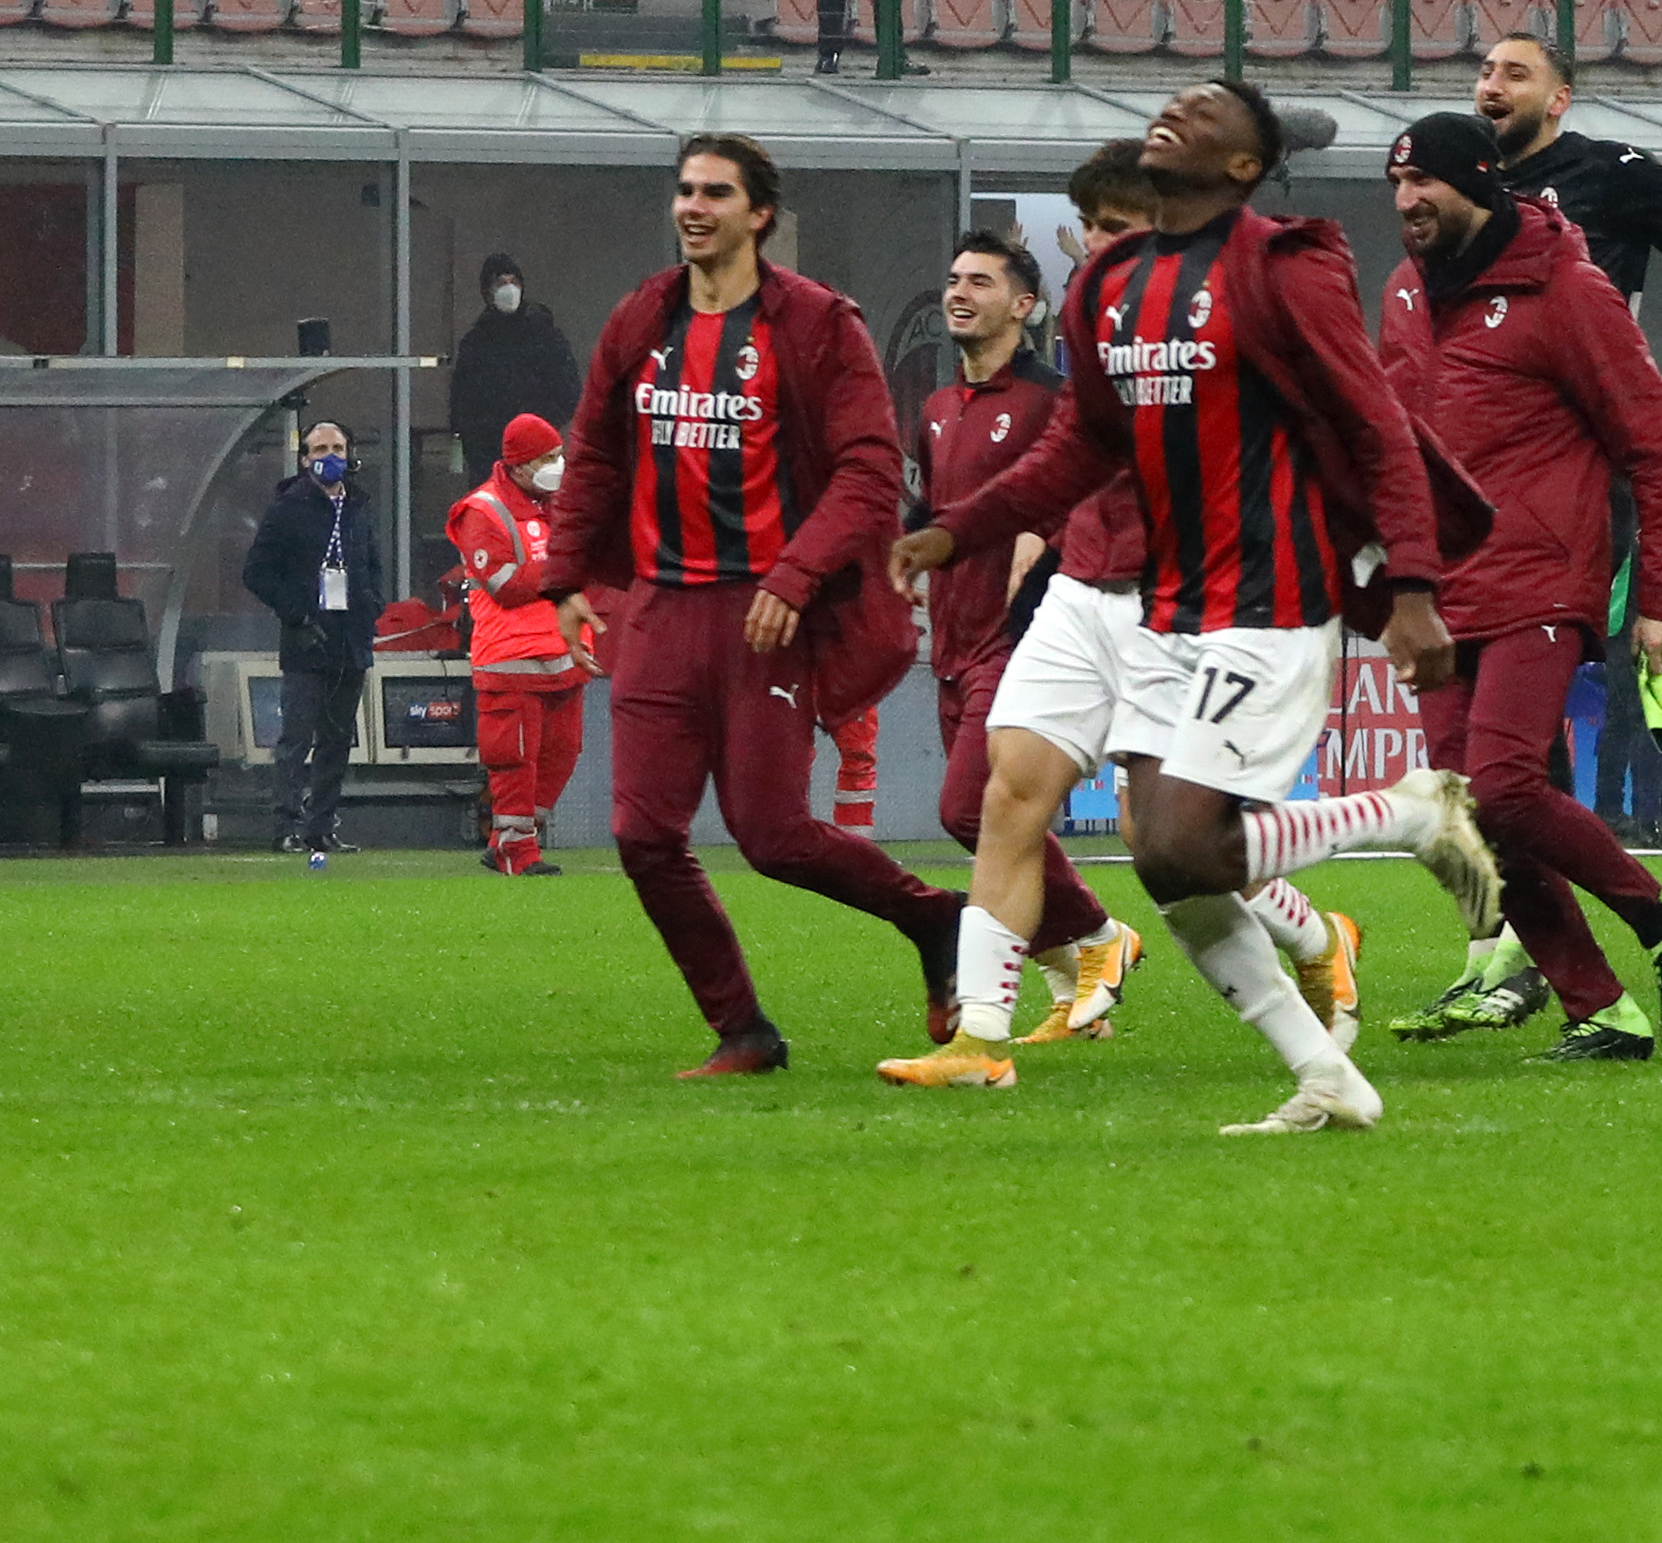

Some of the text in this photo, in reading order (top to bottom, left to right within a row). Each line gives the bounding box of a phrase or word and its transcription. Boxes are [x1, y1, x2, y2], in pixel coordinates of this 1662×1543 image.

[635, 383, 763, 421] Emirates
[1136, 375, 1193, 406] BETTER
[674, 422, 740, 449] BETTER
[1195, 666, 1256, 724] 17
[409, 703, 427, 720] sky
